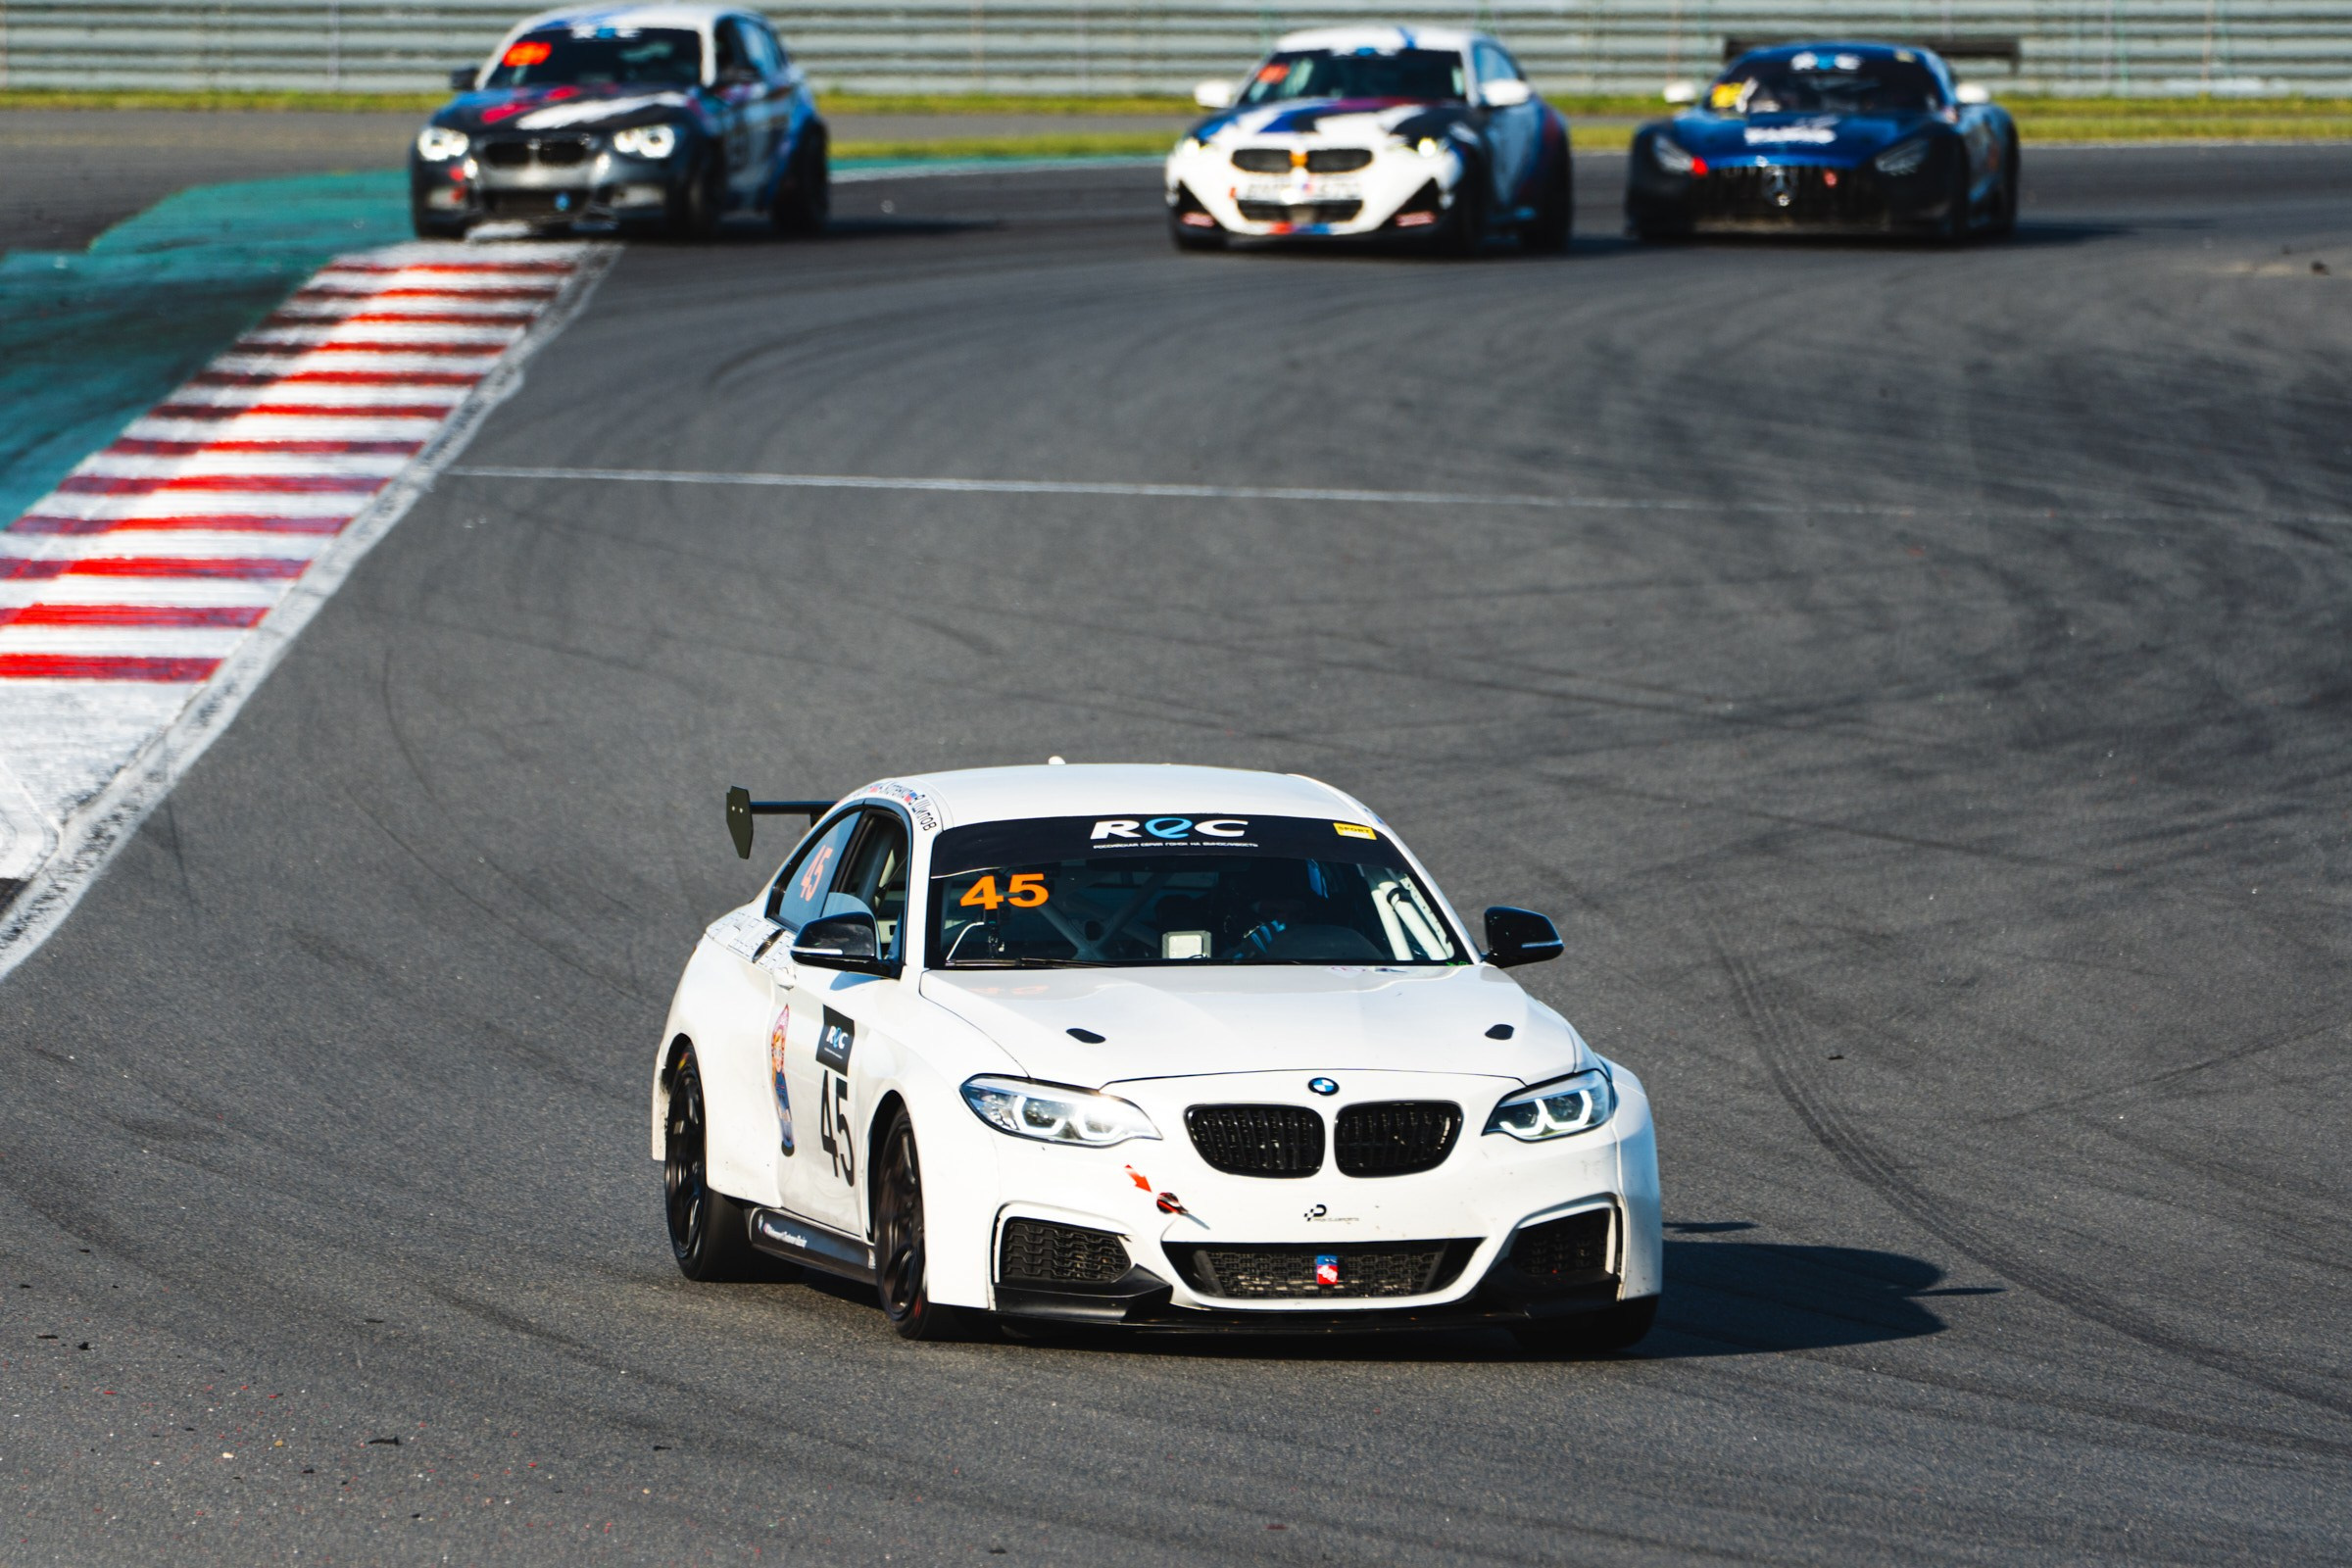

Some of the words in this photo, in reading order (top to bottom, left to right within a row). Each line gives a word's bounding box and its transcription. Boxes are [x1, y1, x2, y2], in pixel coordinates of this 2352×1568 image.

[800, 845, 833, 902] 45
[959, 873, 1050, 910] 45
[821, 1069, 855, 1187] 45
